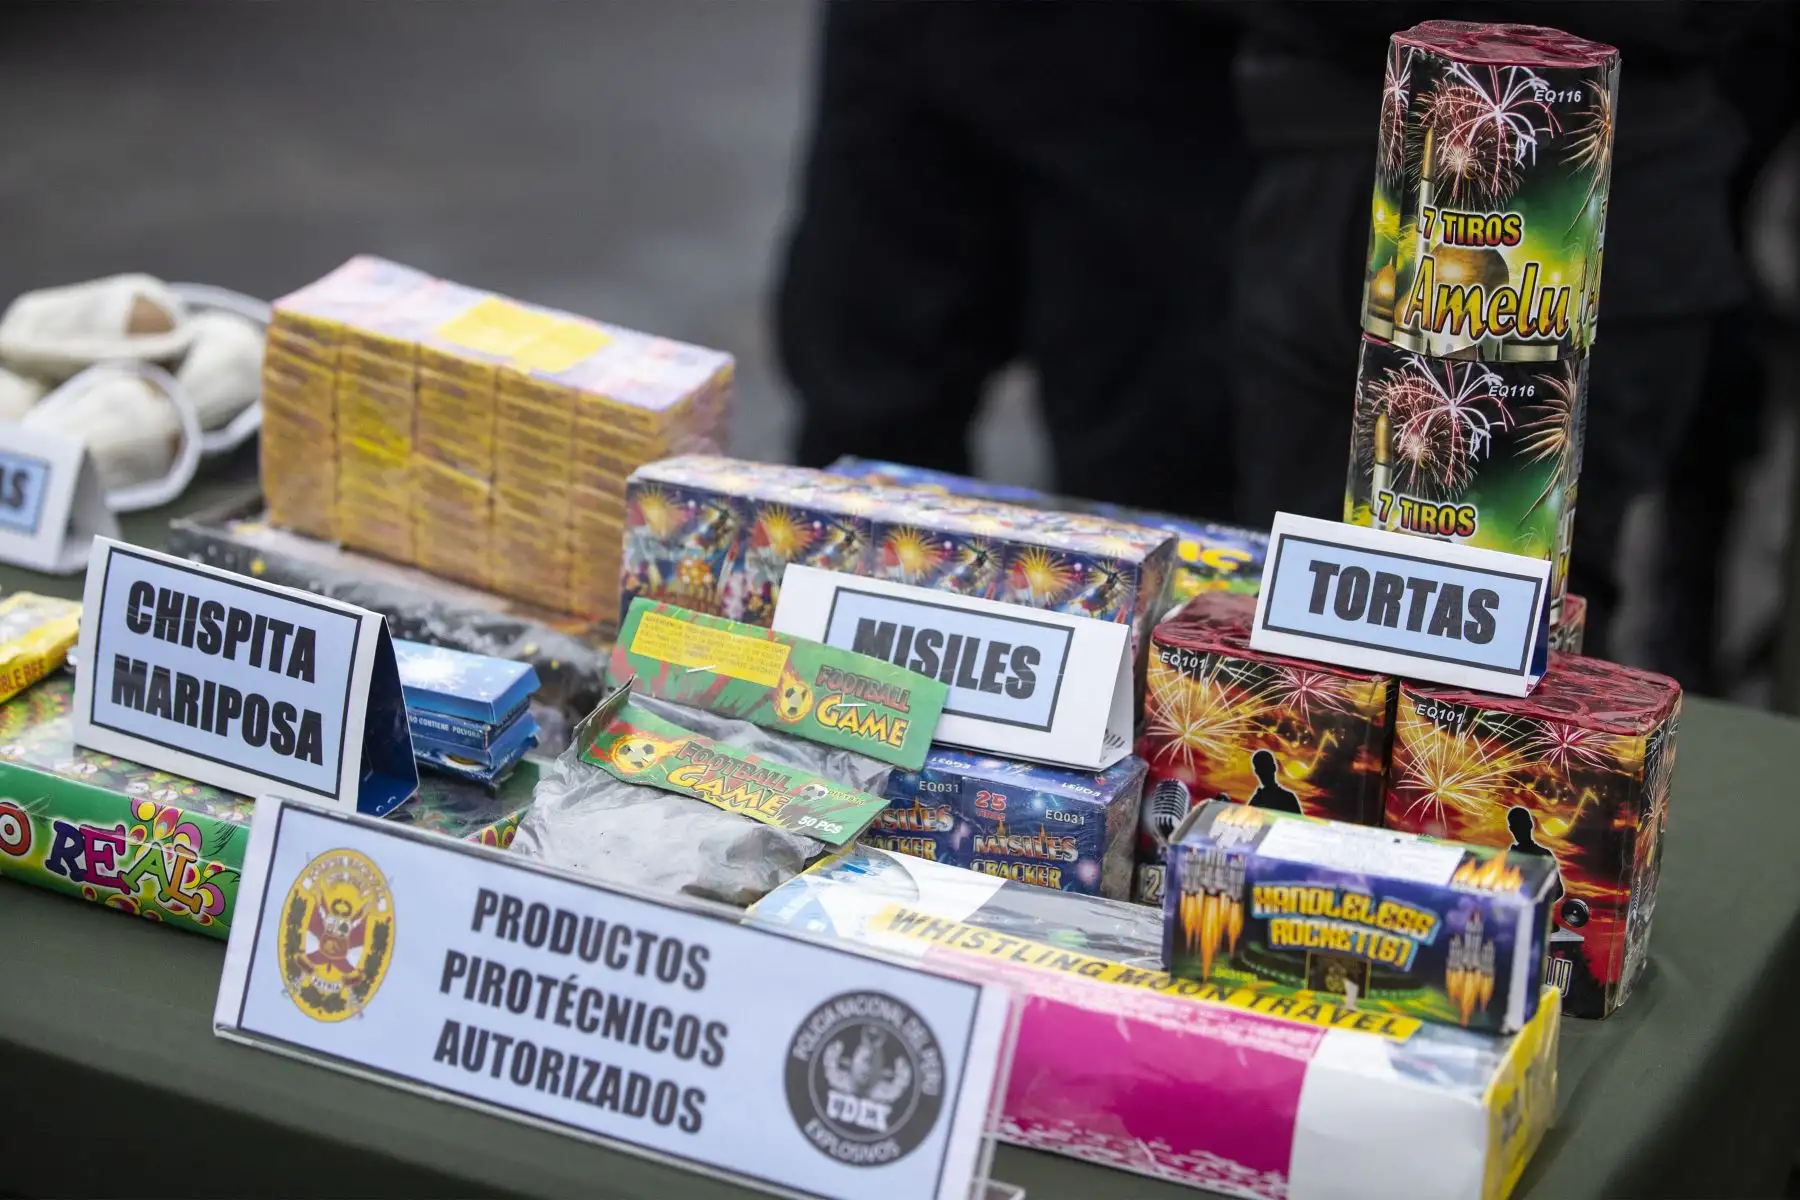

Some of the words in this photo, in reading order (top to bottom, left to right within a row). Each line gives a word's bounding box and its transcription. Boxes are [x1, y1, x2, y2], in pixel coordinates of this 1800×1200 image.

[1534, 89, 1582, 103] EQ116
[1423, 206, 1437, 240] 7
[1441, 211, 1522, 247] TIROS
[1404, 255, 1570, 341] Amelu
[1488, 384, 1535, 398] EQ116
[1378, 491, 1394, 523] 7
[1399, 495, 1476, 537] TIROS
[1308, 559, 1500, 645] TORTAS
[126, 580, 317, 684] CHISPITA
[852, 617, 1041, 699] MISILES
[1160, 651, 1207, 670] EQ101
[111, 653, 323, 766] MARIPOSA
[815, 664, 911, 713] FOOTBALL
[1415, 703, 1464, 724] EQ101
[418, 715, 449, 731] CONTIENE
[815, 693, 910, 749] GAME
[666, 764, 791, 817] GAME
[675, 741, 792, 793] FOOTBALL
[919, 780, 959, 793] EQ031
[798, 816, 814, 828] 50
[815, 820, 843, 834] PCS
[872, 804, 954, 832] ISILES
[975, 790, 1007, 811] 25
[1045, 809, 1085, 826] EQ031
[45, 820, 204, 914] REAL
[973, 834, 1079, 863] MISILES
[1253, 886, 1437, 940] HANDLELESS
[471, 888, 711, 991] PRODUCTOS
[887, 908, 1109, 977] WHISTLING
[1112, 965, 1233, 1001] MOON
[1248, 991, 1398, 1036] TRAVEL
[439, 948, 729, 1068] PIROTÉCNICOS
[432, 1018, 706, 1134] AUTORIZADOS
